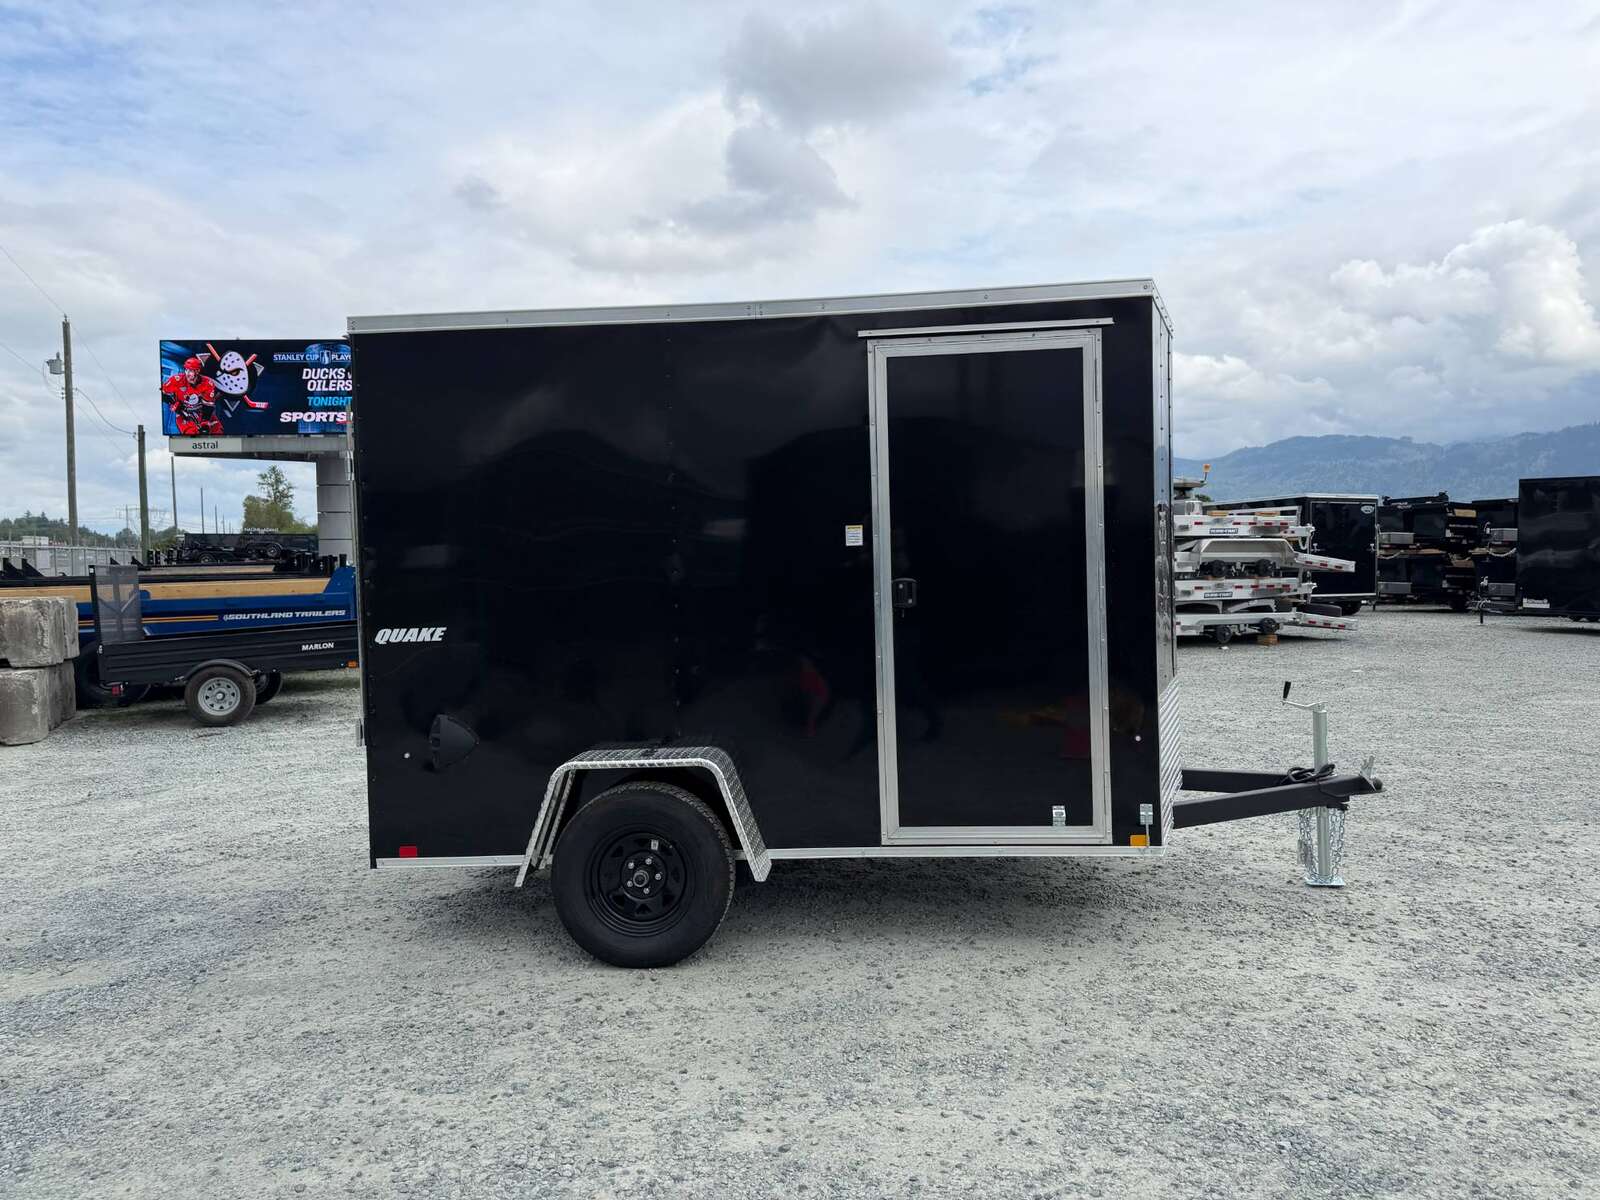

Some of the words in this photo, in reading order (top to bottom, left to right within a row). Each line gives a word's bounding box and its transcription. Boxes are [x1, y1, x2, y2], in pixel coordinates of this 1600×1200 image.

[302, 368, 346, 380] DUCKS
[307, 380, 353, 391] OILERS
[307, 396, 353, 407] TONIGHT
[280, 411, 353, 423] SPORTS
[192, 440, 219, 450] astral
[228, 611, 293, 620] SOUTHLAND
[294, 609, 346, 618] TRAILERS
[374, 627, 447, 645] QUAKE
[301, 642, 335, 651] MARLON
